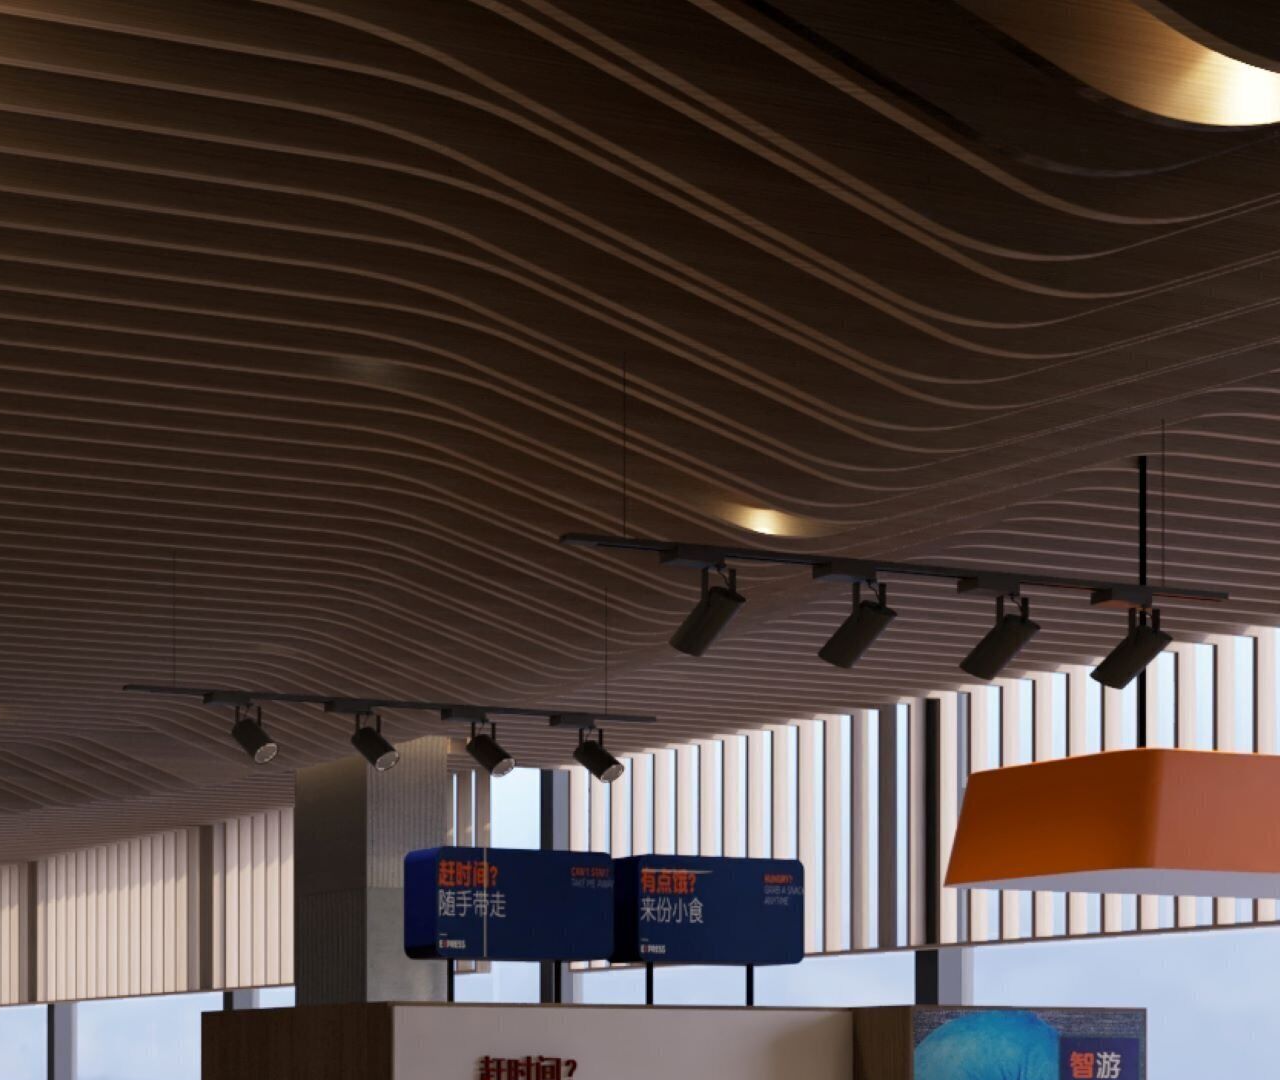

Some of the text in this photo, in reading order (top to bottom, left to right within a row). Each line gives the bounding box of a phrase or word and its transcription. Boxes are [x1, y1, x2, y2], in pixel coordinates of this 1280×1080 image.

[438, 889, 506, 918] 随手带走
[640, 897, 704, 924] 来份小食
[1070, 1051, 1121, 1080] 智游
